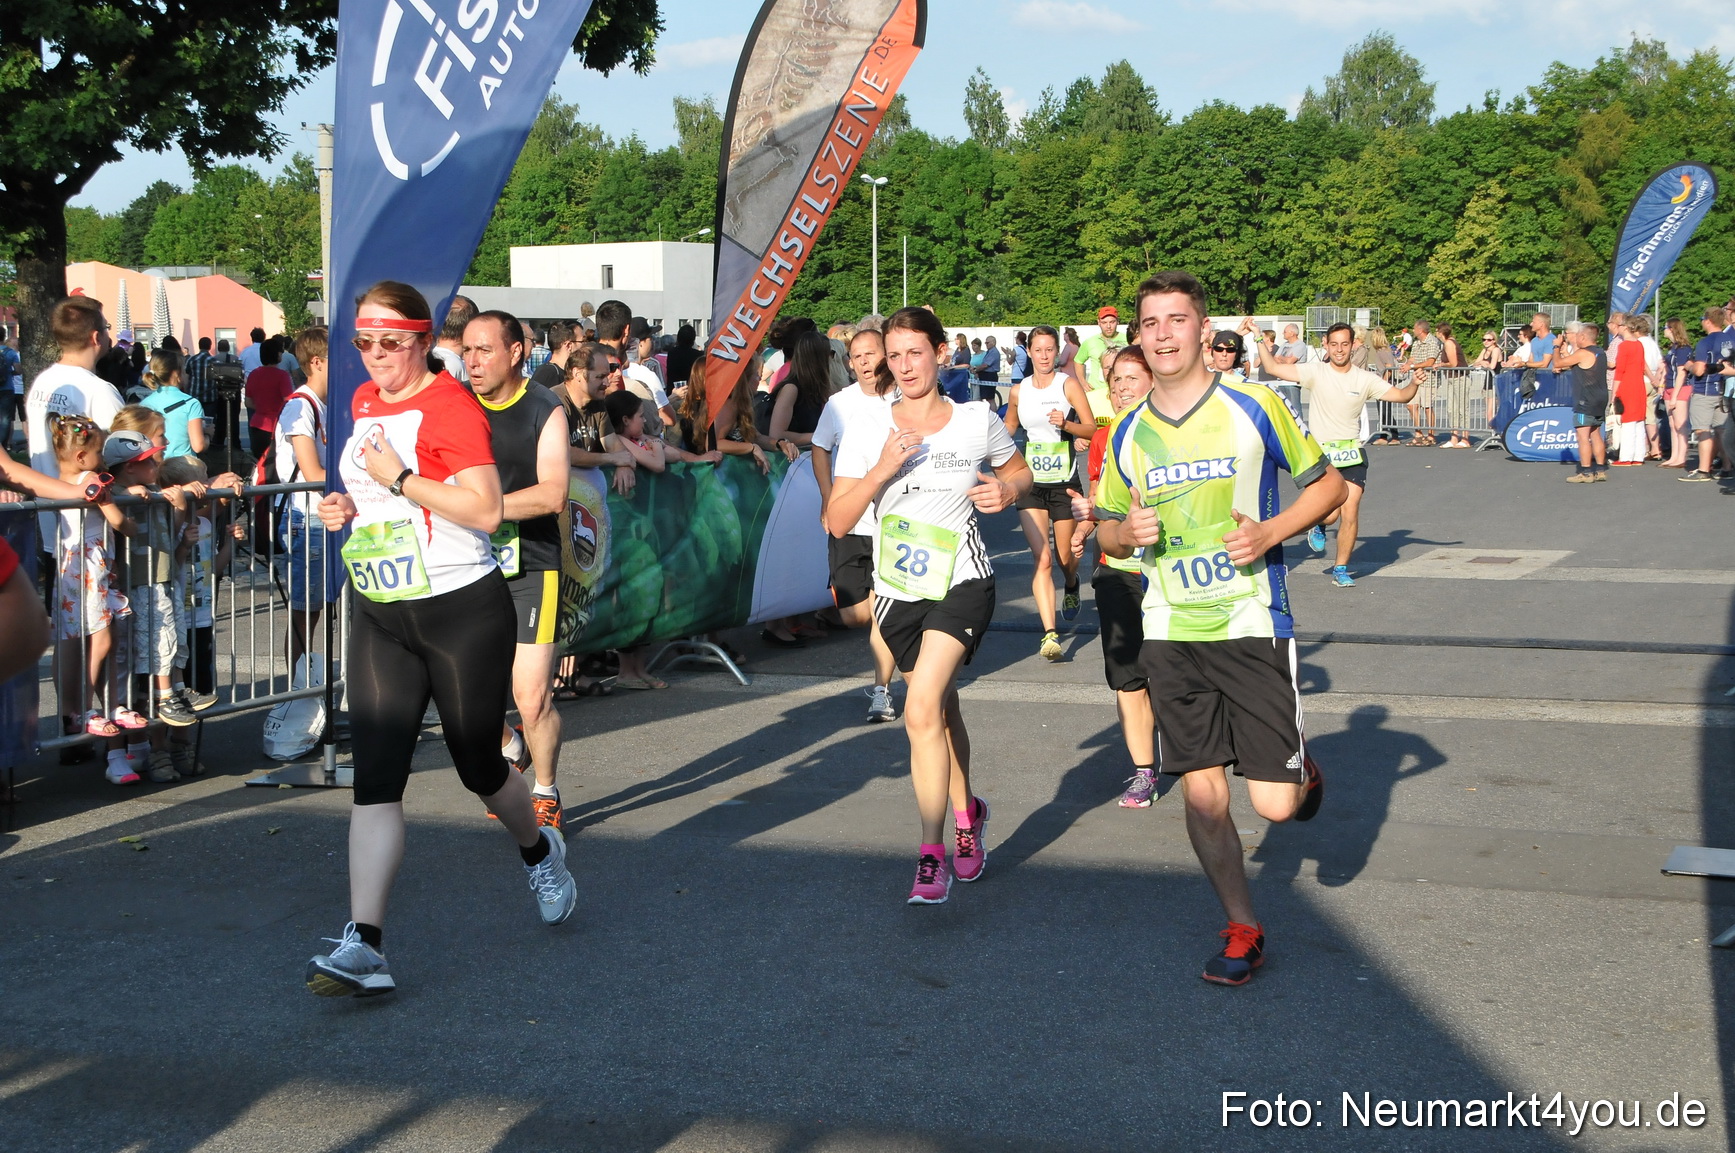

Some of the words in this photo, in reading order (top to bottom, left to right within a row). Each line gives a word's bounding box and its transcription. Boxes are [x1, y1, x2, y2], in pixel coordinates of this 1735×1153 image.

[1616, 205, 1686, 292] Frischmann
[931, 452, 957, 461] HECK
[934, 459, 972, 469] DESIGN
[1032, 456, 1062, 472] 884
[1146, 456, 1237, 491] BOCK
[351, 554, 415, 591] 5107
[894, 543, 930, 577] 28
[1171, 551, 1236, 589] 108
